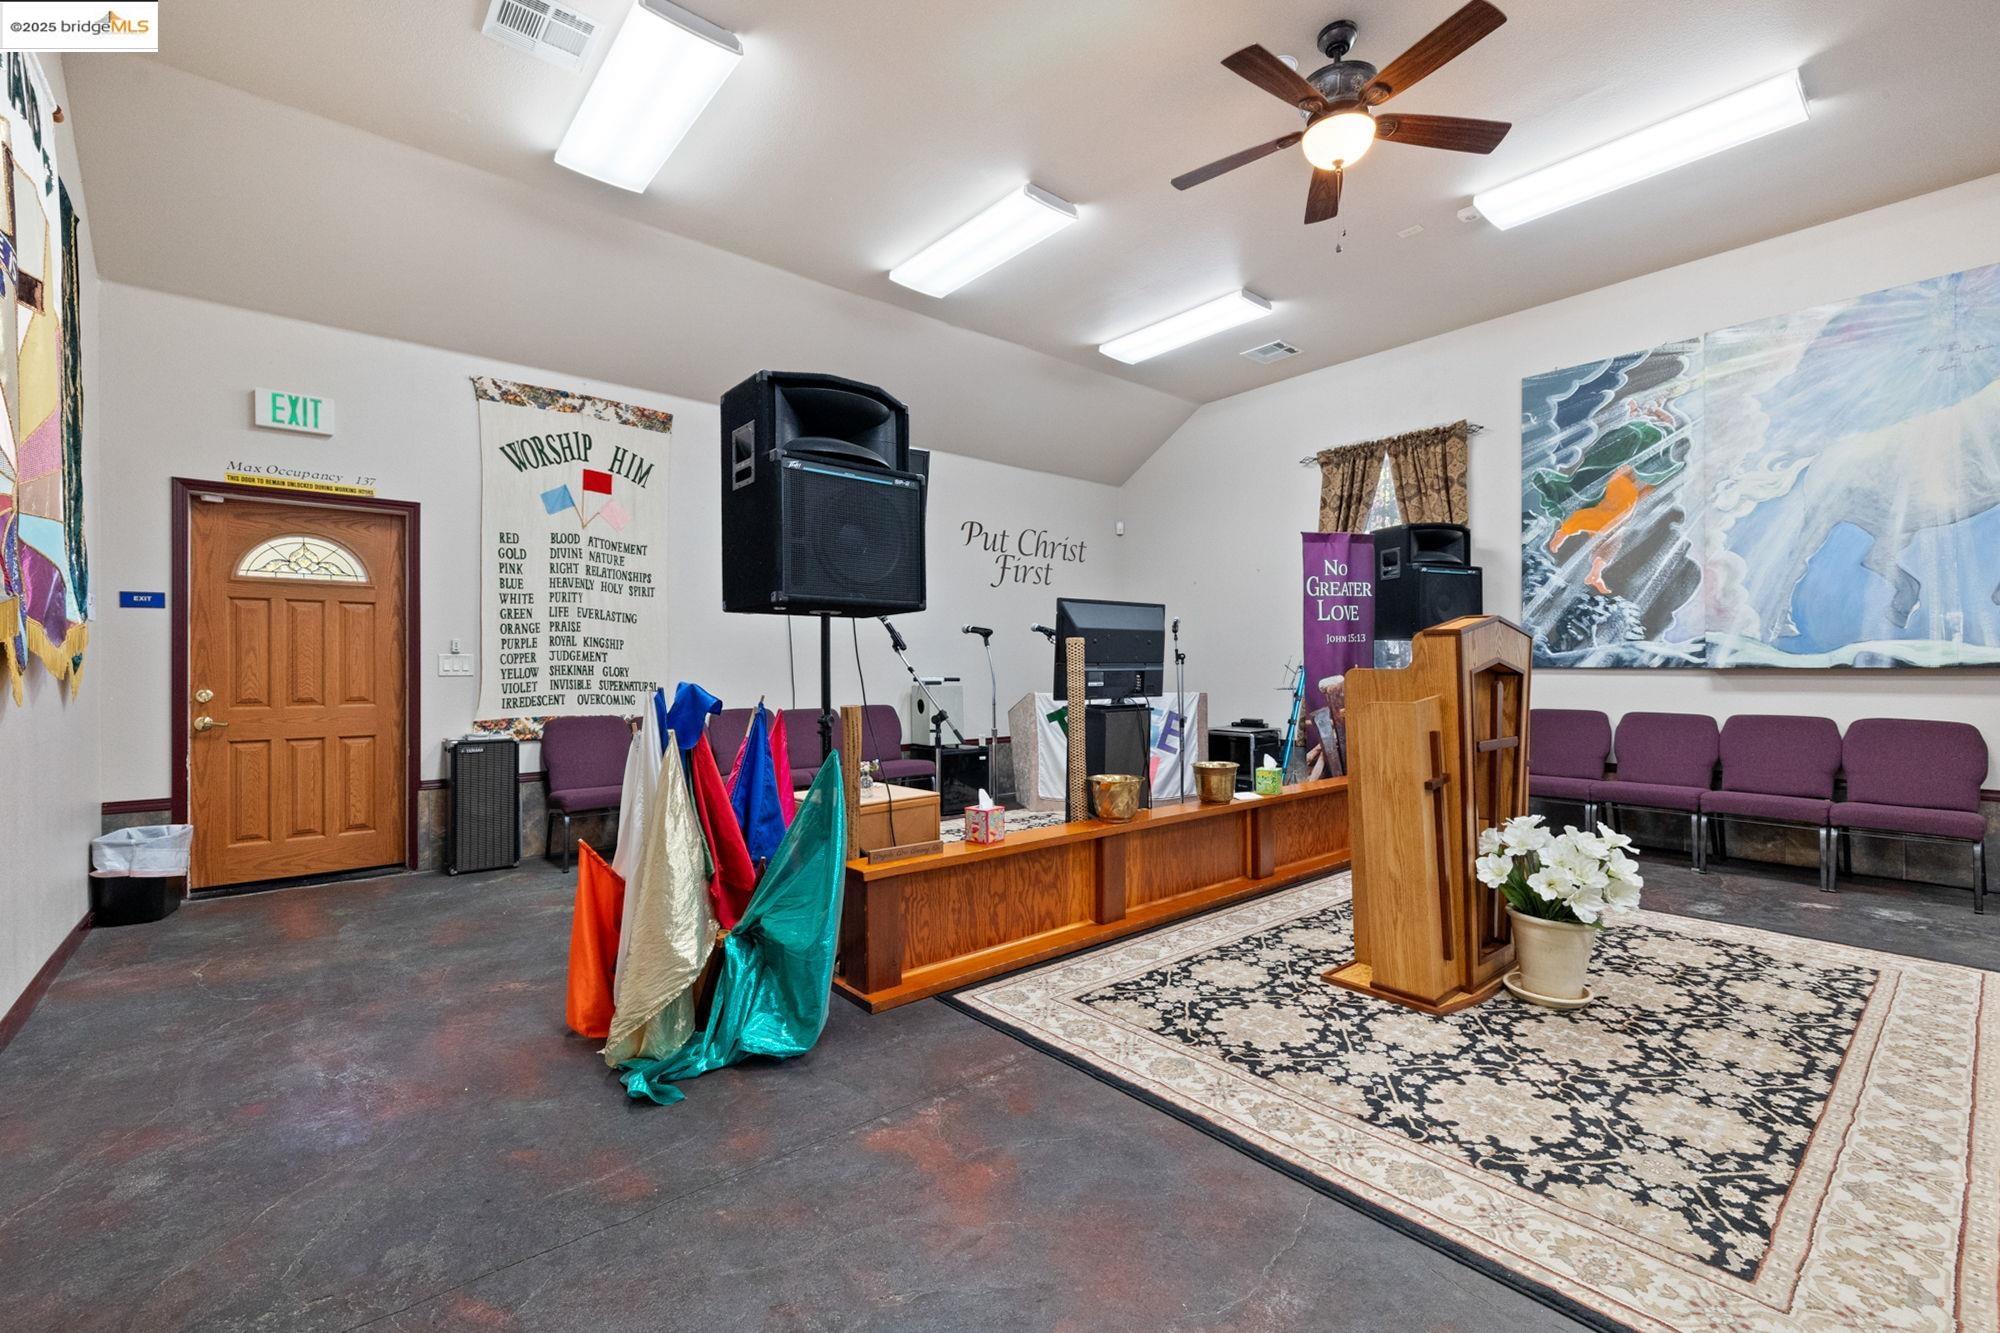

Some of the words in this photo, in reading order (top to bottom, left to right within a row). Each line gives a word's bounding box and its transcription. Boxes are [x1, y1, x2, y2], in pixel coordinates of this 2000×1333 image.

[271, 393, 322, 428] EXIT
[499, 431, 593, 472] WORSHIP
[608, 445, 655, 489] HIM
[226, 461, 262, 473] Max
[266, 465, 343, 482] Occupancy
[356, 476, 376, 486] 137
[287, 481, 313, 489] UNLOCKED
[499, 532, 519, 544] RED
[550, 533, 580, 544] BLOOD
[588, 536, 647, 556] ATTONEMENT
[961, 521, 1009, 553] Put
[1018, 529, 1087, 562] Christ
[498, 548, 527, 560] GOLD
[550, 548, 583, 559] DIVINE
[589, 551, 625, 566] NATURE
[499, 563, 523, 574] PINK
[549, 563, 580, 574] RIGHT
[585, 565, 652, 583] RELATIONSHIPS
[990, 554, 1054, 588] First
[1324, 560, 1348, 576] NO
[499, 578, 523, 589] BLUE
[549, 578, 594, 590] HEAVENLY
[601, 582, 623, 594] HOLY
[628, 586, 655, 598] SPIRIT
[1306, 576, 1372, 597] GREATER
[499, 593, 534, 604] WHITE
[549, 592, 583, 603] PURITY
[500, 608, 533, 619] GREEN
[549, 607, 569, 618] LIFE
[577, 607, 637, 624] EVERLASTING
[1317, 600, 1359, 621] LOVE
[500, 623, 541, 634] ORANGE
[549, 622, 581, 632] PRAISE
[501, 638, 537, 650] PURPLE
[549, 636, 577, 647] ROYAL
[583, 637, 624, 650] KINGSHIP
[1326, 634, 1346, 644] JOHN
[1348, 634, 1366, 642] 15:13
[500, 653, 536, 664] COPPER
[549, 651, 608, 663] JUDGEMENT
[500, 667, 539, 679] YELLOW
[549, 665, 594, 676] SHEKINAH
[602, 667, 630, 677] GLORY
[501, 682, 537, 694] VIOLET
[550, 680, 592, 691] INVISIBLE
[501, 695, 565, 709] IRREDESCENT
[577, 694, 636, 706] OVERCOMING
